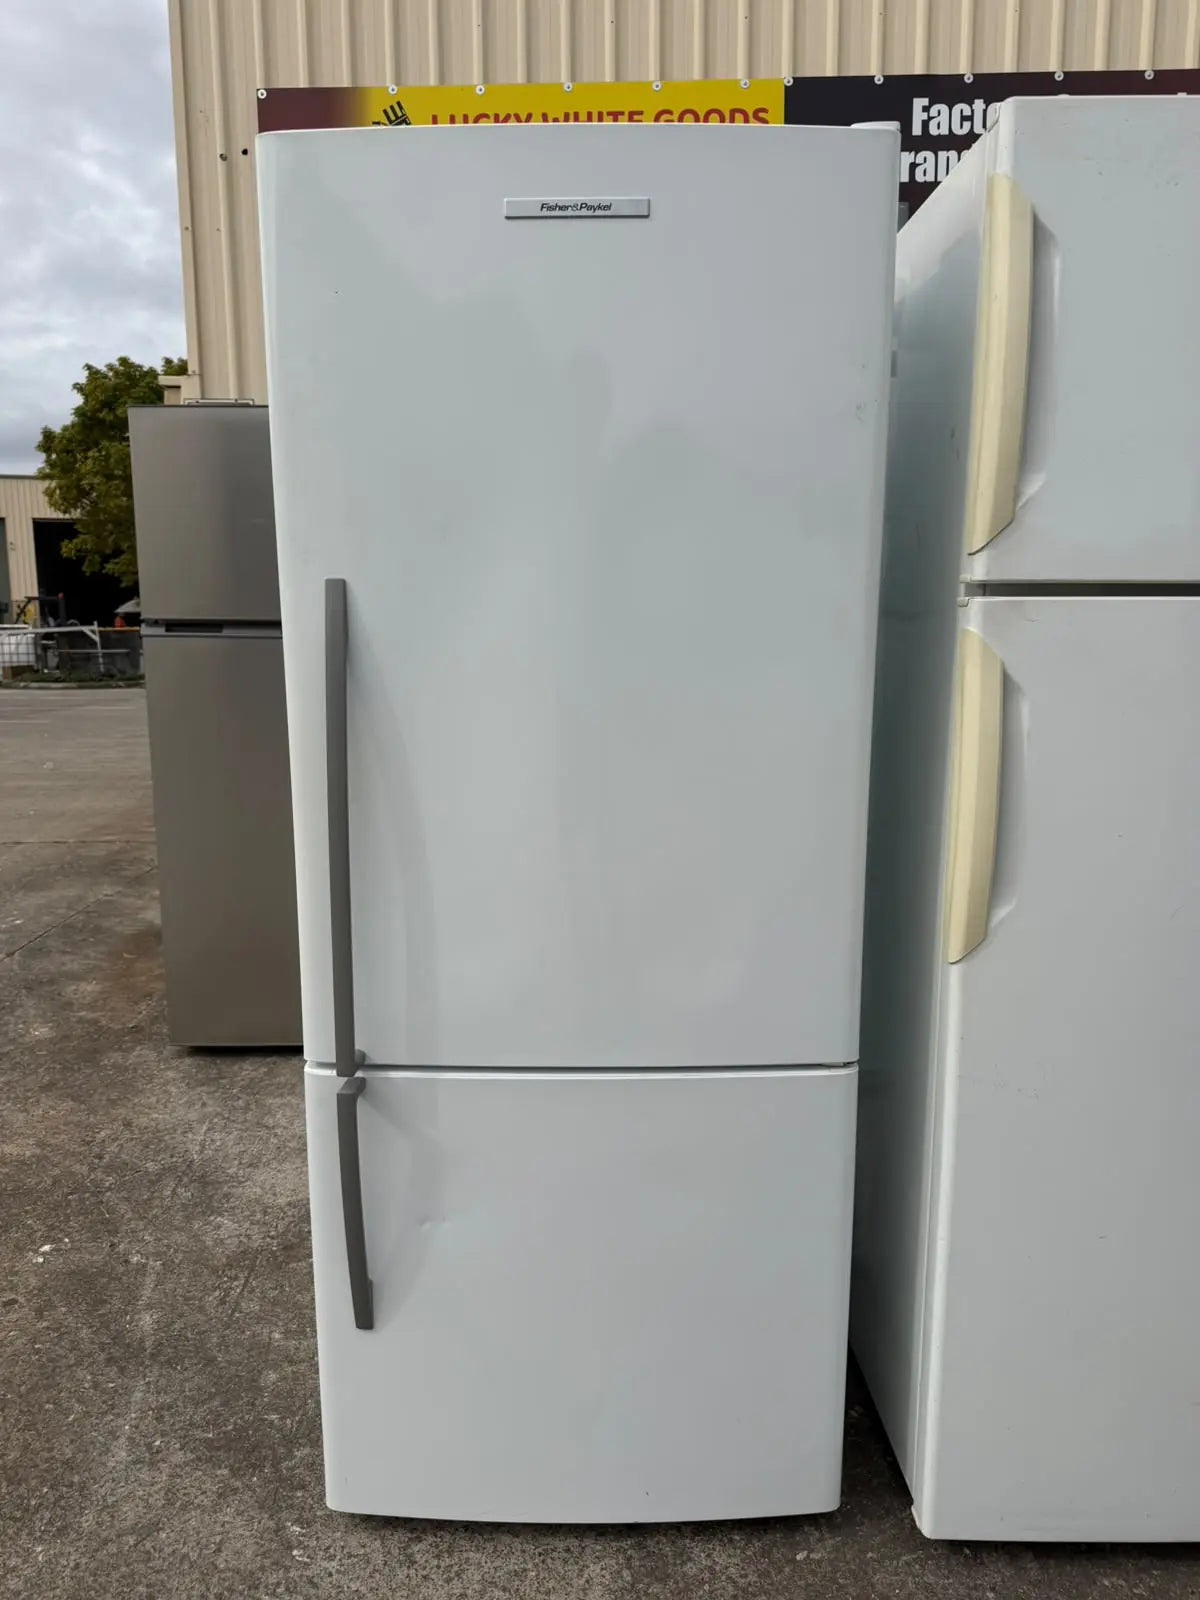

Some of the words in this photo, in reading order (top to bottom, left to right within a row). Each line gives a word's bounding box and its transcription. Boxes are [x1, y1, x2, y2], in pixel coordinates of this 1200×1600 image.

[653, 107, 770, 124] GOODS
[900, 149, 970, 183] ran
[540, 202, 612, 213] Fisher&Paykel
